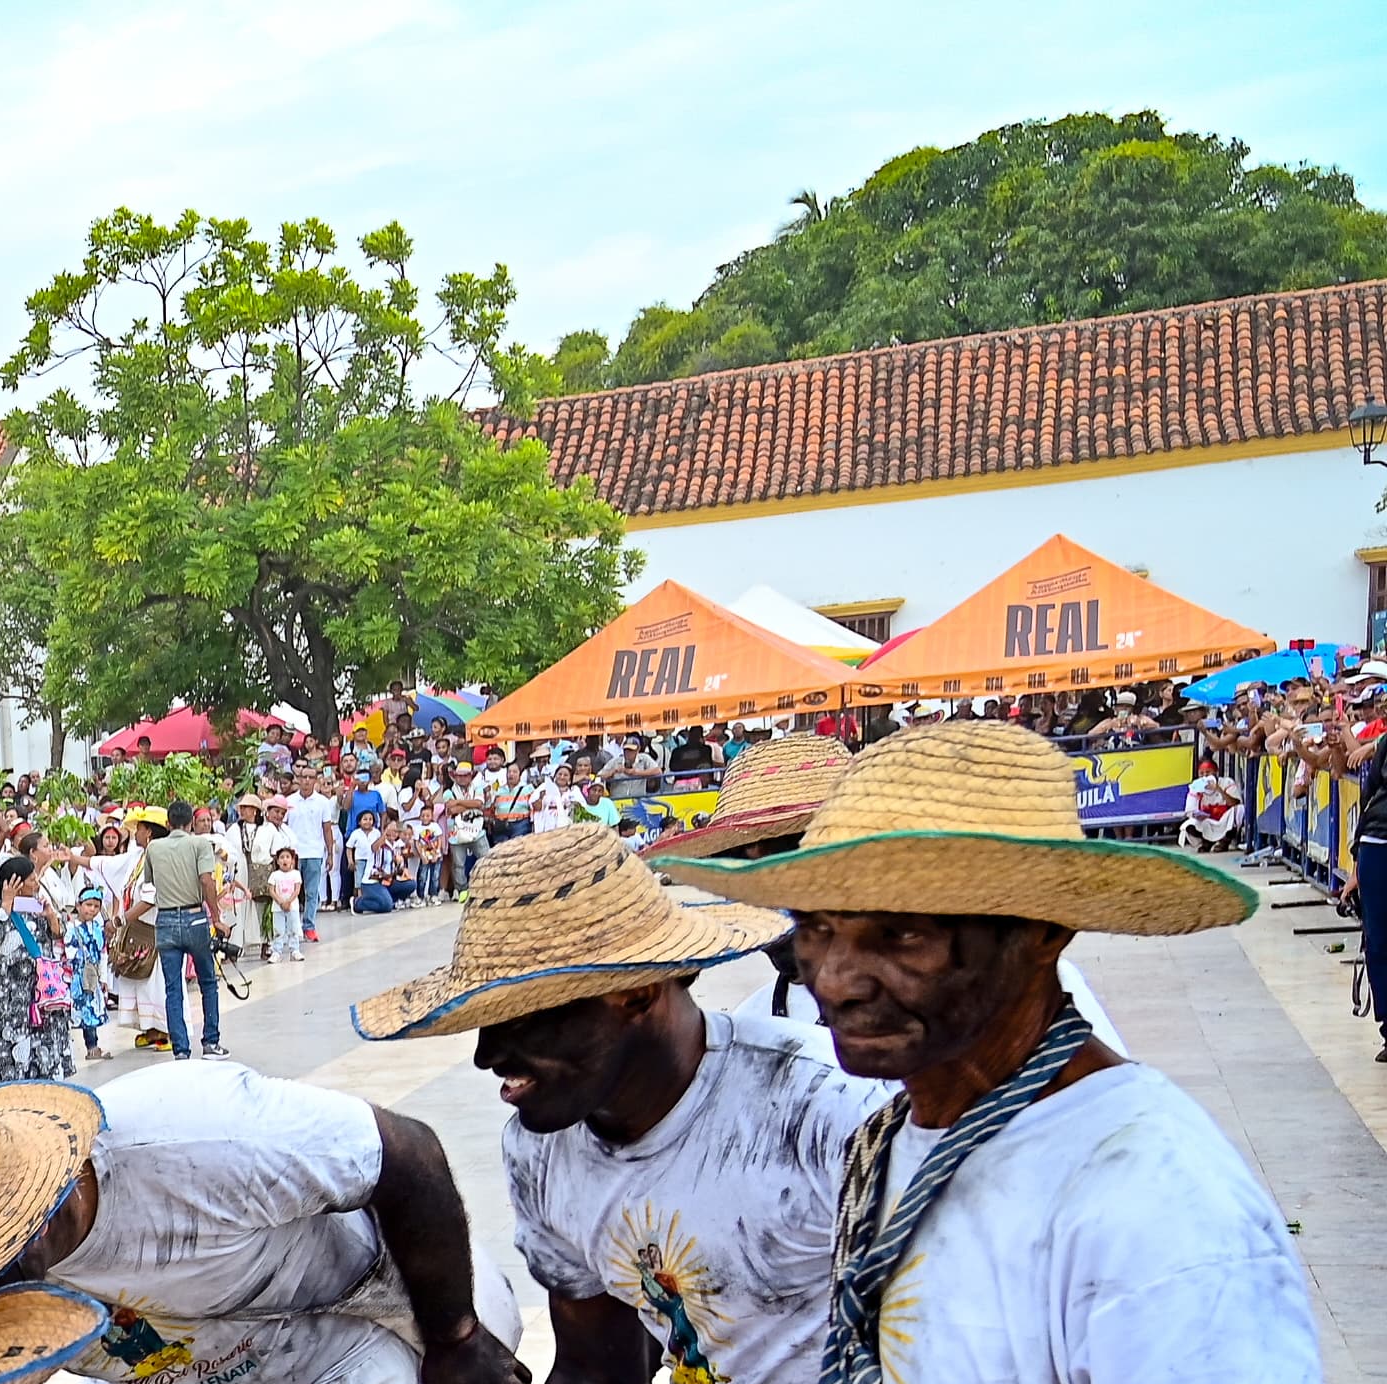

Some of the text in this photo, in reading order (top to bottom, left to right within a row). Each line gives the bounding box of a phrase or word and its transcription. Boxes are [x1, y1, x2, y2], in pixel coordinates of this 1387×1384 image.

[1004, 599, 1109, 658] REAL
[606, 644, 698, 700] REAL
[1077, 785, 1116, 809] UILA
